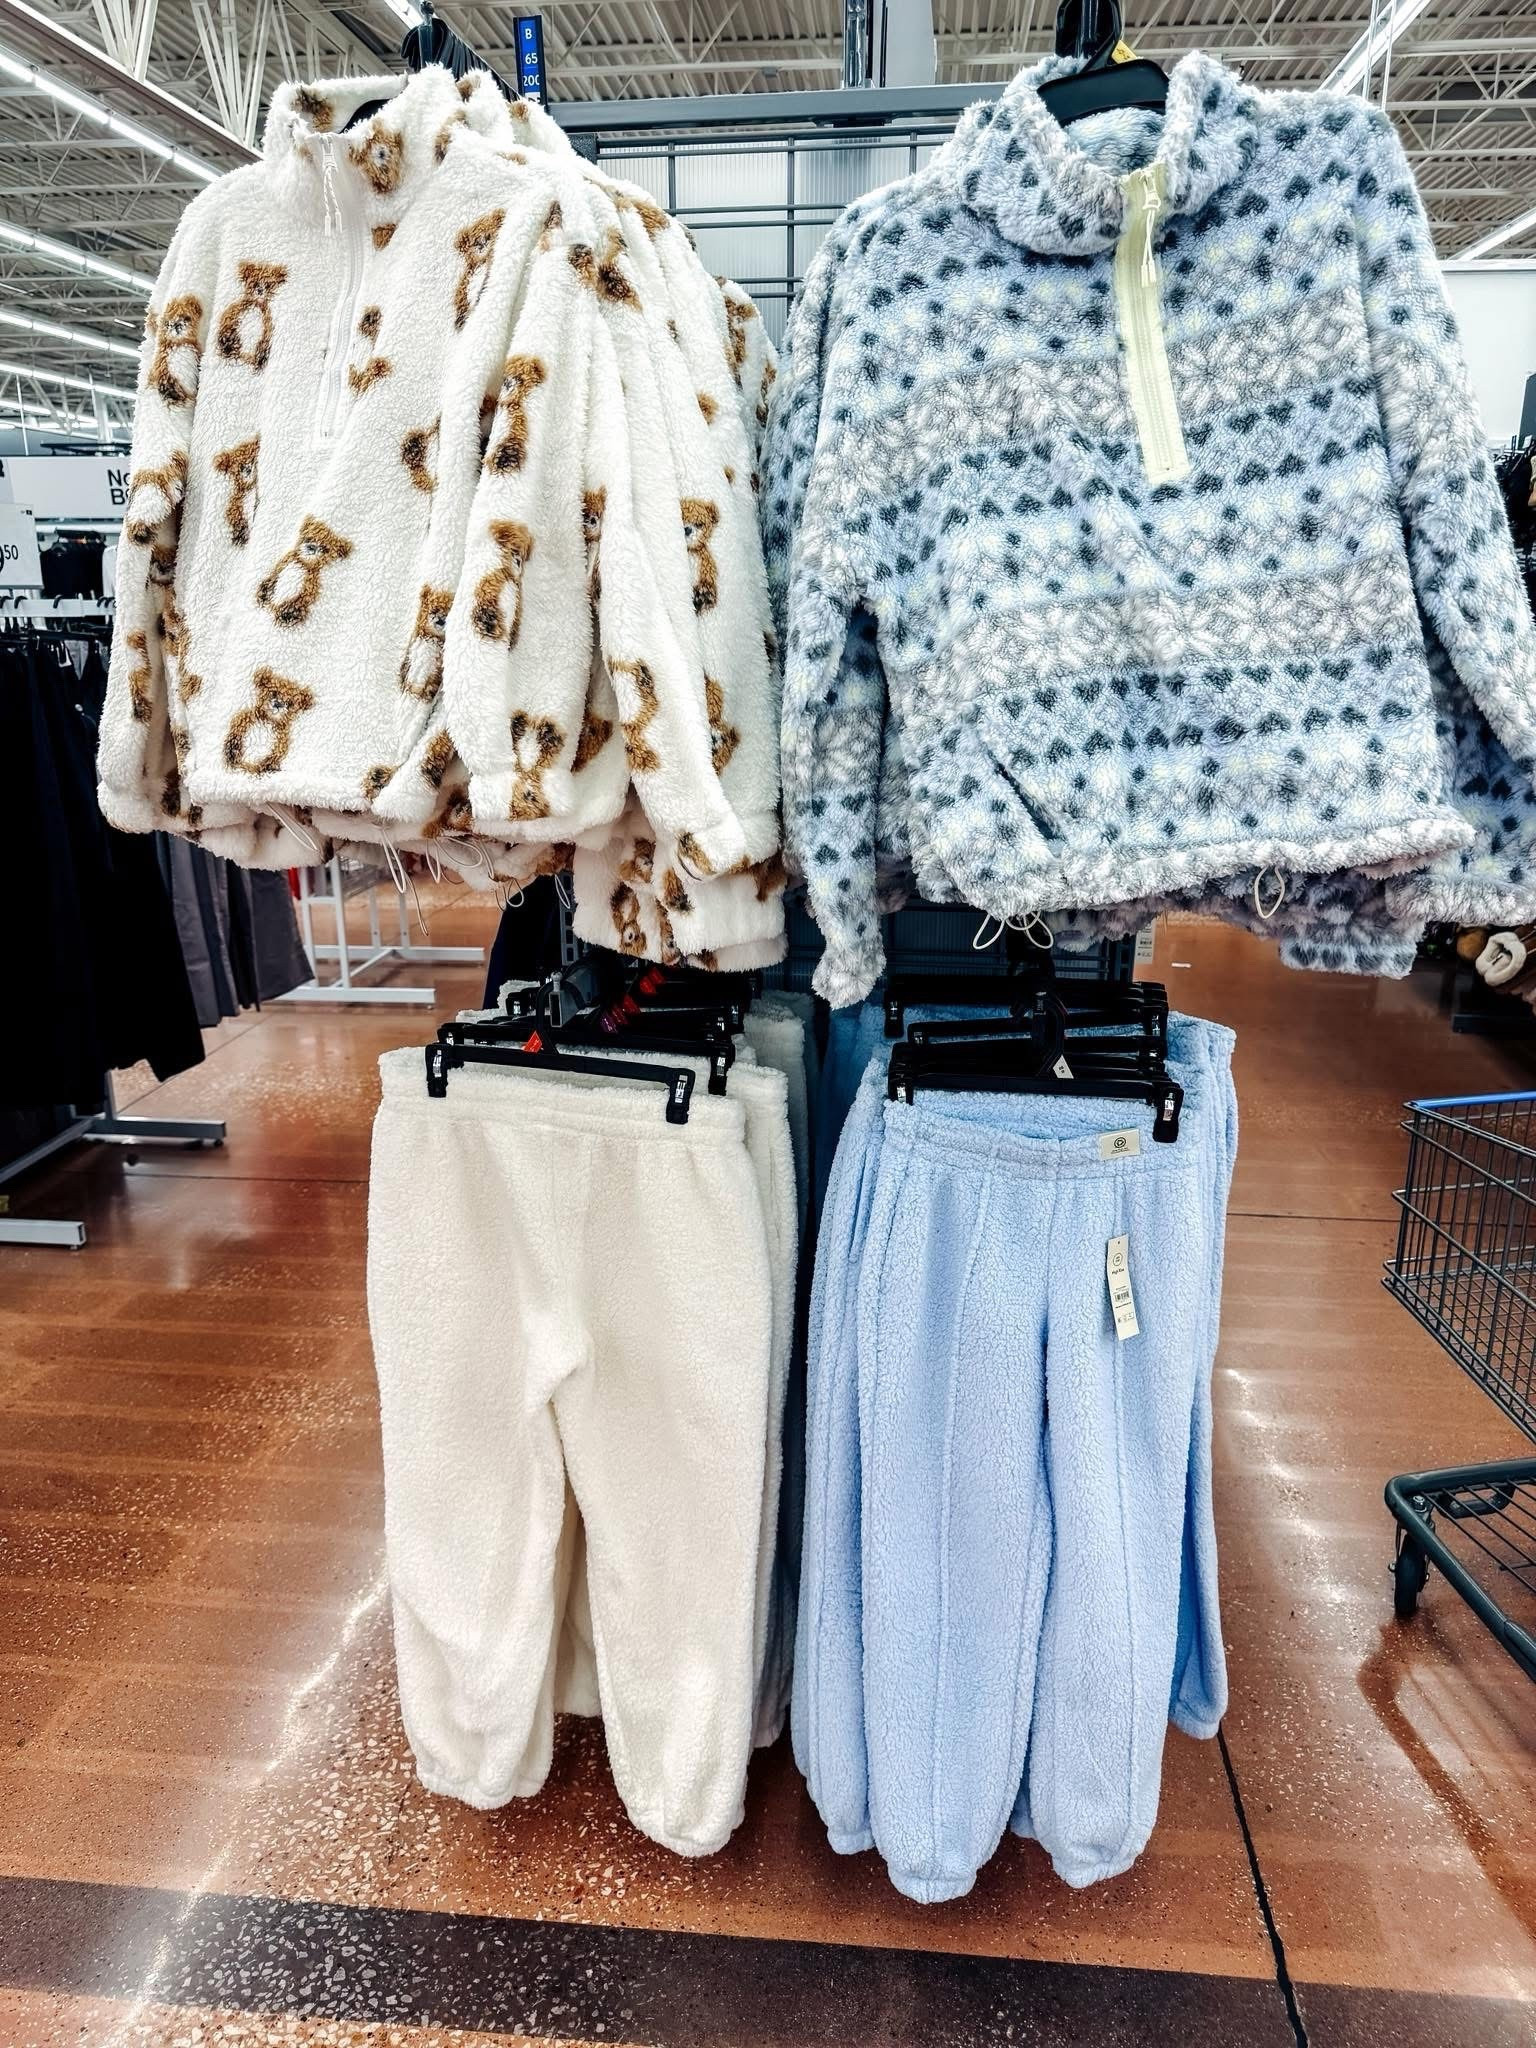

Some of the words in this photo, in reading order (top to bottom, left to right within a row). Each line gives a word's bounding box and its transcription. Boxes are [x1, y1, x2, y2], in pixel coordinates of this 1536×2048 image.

[525, 28, 533, 40] B
[525, 52, 539, 65] 65
[110, 487, 129, 505] B
